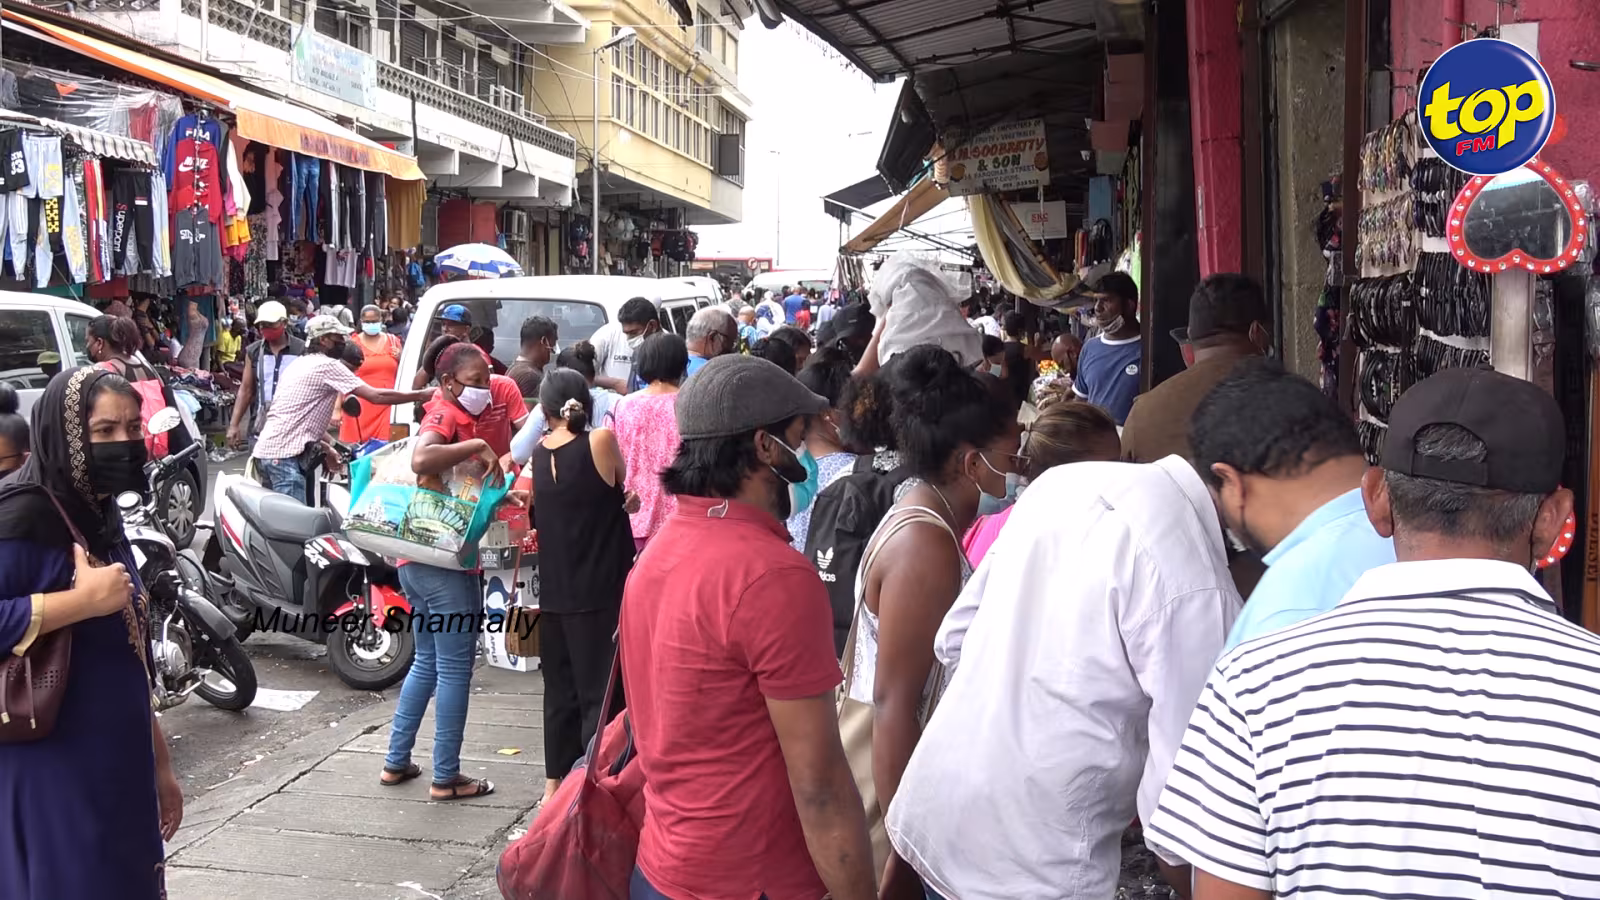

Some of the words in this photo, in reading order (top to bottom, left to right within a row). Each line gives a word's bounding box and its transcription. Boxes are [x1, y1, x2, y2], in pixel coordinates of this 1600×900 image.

[185, 129, 210, 140] FILA
[977, 158, 988, 171] &
[993, 154, 1021, 168] SON
[114, 203, 128, 252] Superpant
[490, 635, 498, 664] APPLES
